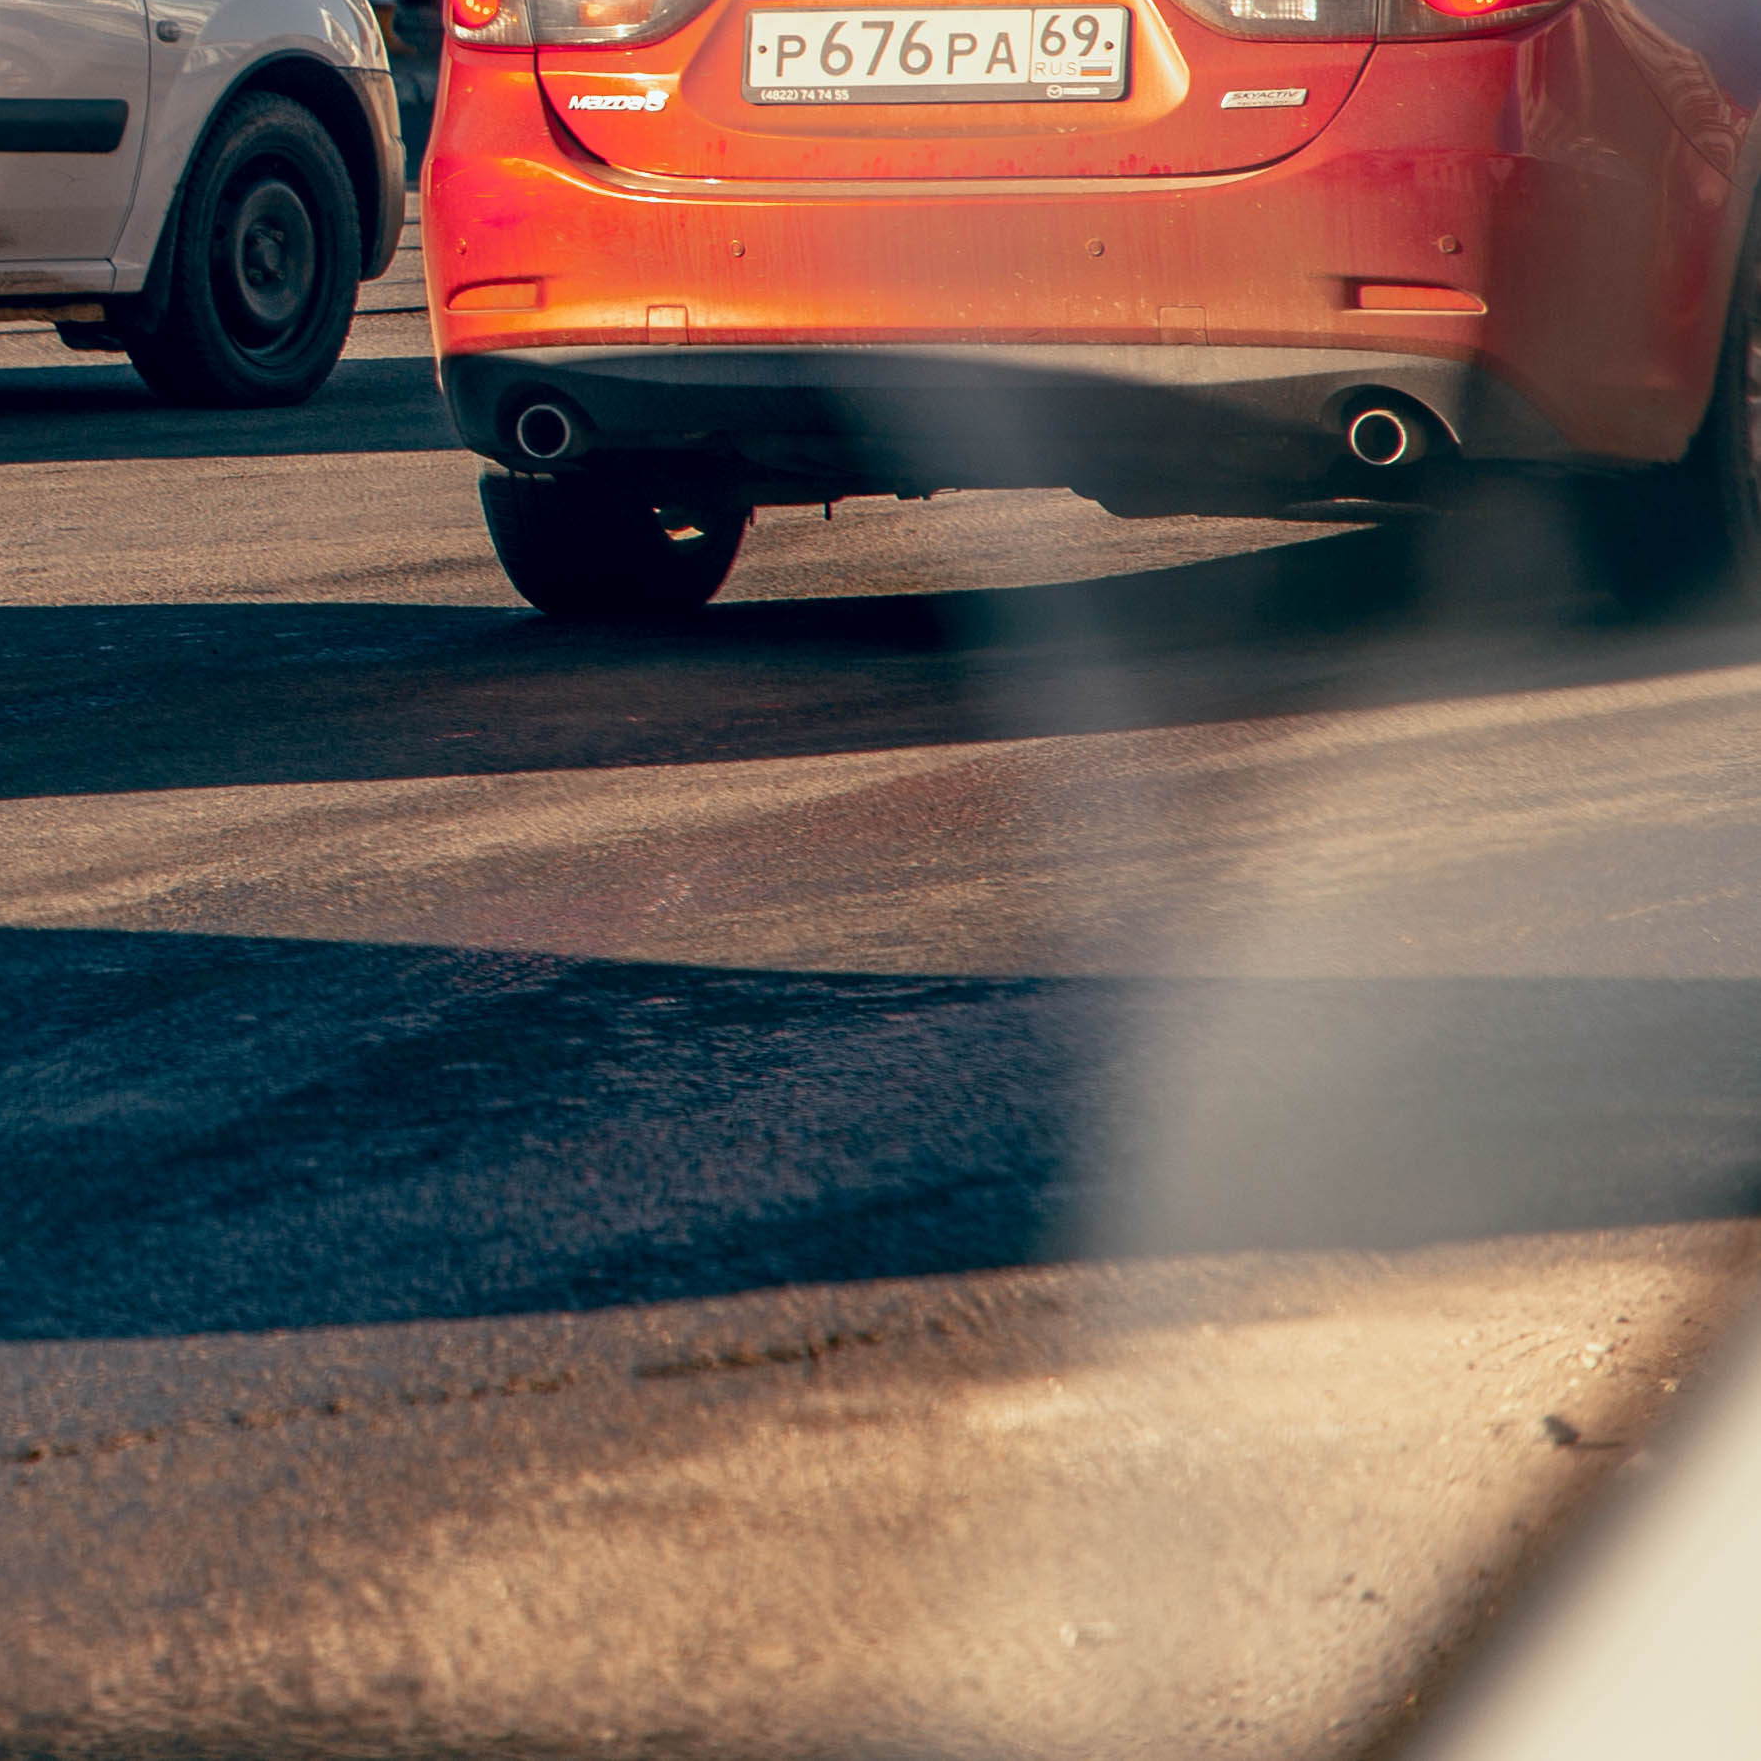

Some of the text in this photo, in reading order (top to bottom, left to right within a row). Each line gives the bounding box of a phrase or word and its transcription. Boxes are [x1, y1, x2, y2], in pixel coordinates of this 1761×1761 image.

[1039, 14, 1101, 57] 69
[1033, 60, 1078, 77] RUS
[760, 89, 799, 101] (4822)
[801, 89, 816, 101] 74
[817, 89, 833, 101] 74
